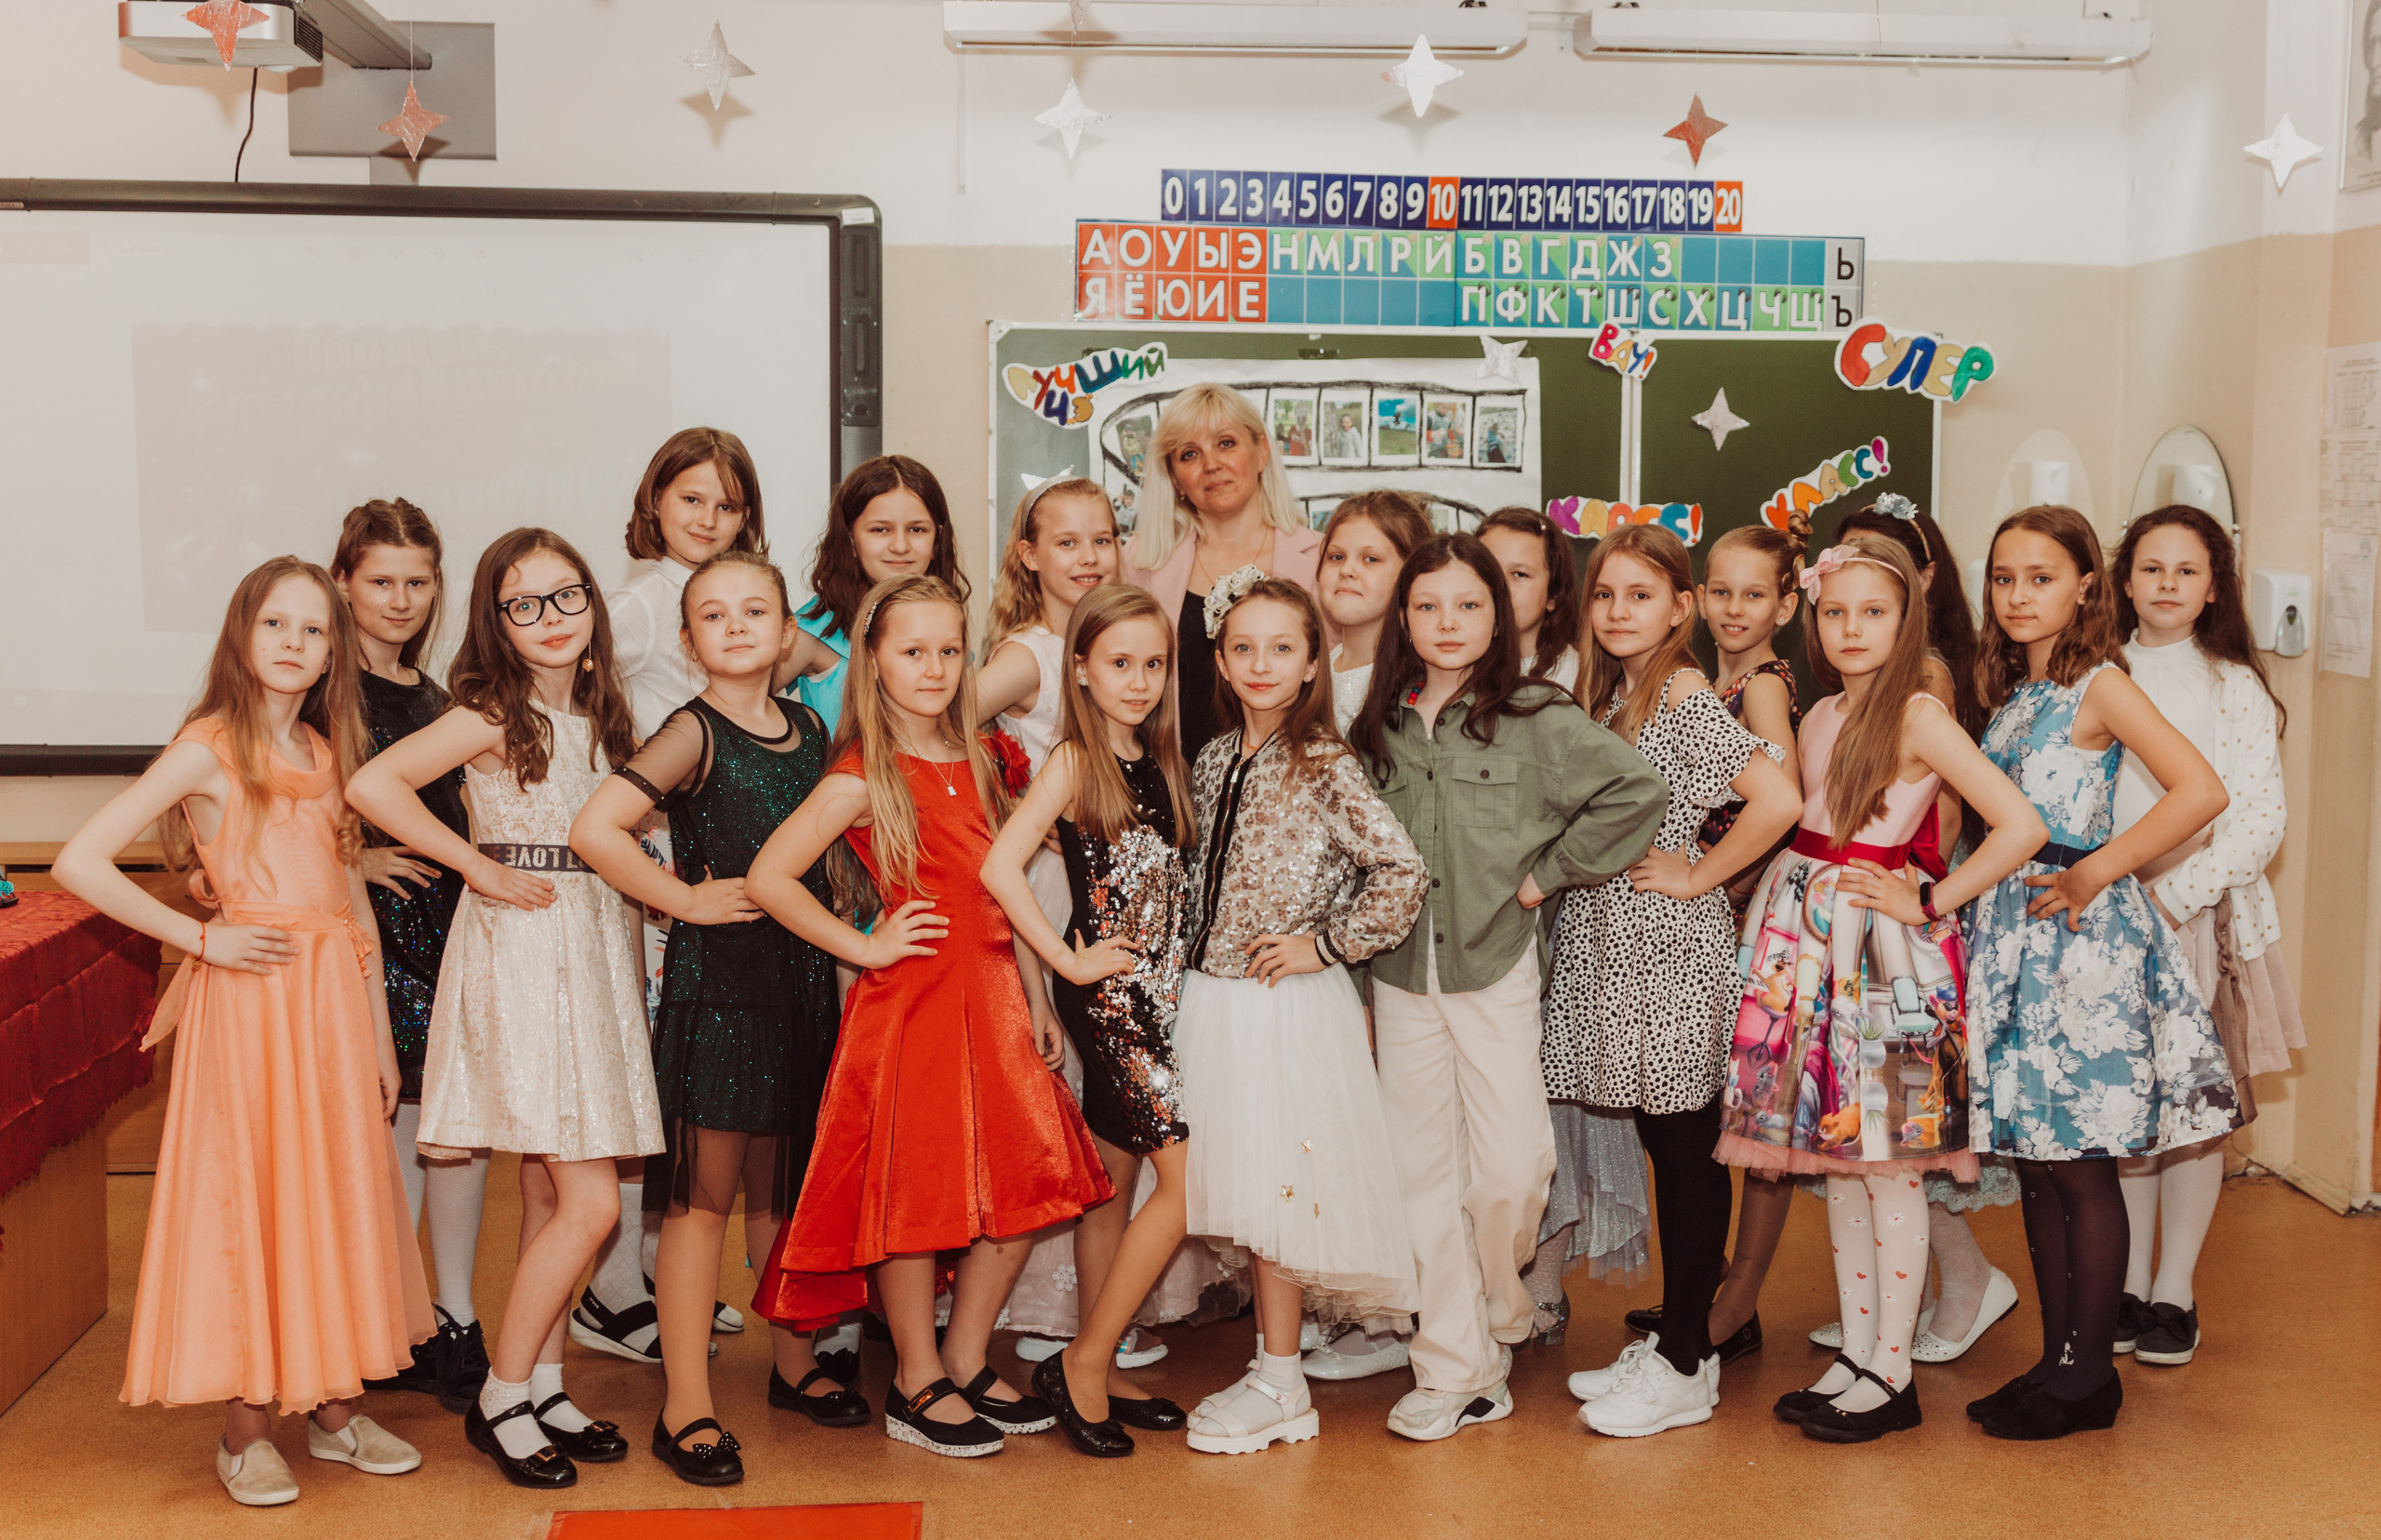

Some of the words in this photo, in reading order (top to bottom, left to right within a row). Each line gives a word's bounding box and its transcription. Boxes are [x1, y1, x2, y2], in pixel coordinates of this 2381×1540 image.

[1164, 178, 1183, 214] 0
[1194, 179, 1206, 215] 1
[1218, 179, 1237, 216] 2
[1245, 179, 1264, 217] 3
[1271, 179, 1292, 217] 4
[1299, 180, 1317, 218] 5
[1325, 181, 1344, 219] 6
[1353, 181, 1372, 219] 7
[1378, 182, 1398, 219] 8
[1405, 183, 1424, 220] 9
[1430, 183, 1456, 221] 10
[1461, 185, 1483, 221] 11
[1489, 185, 1513, 221] 12
[1518, 186, 1542, 222] 13
[1547, 186, 1571, 222] 14
[1576, 186, 1600, 223] 15
[1604, 186, 1629, 223] 16
[1632, 187, 1656, 224] 17
[1661, 187, 1684, 224] 18
[1689, 188, 1712, 225] 19
[1716, 188, 1740, 225] 20
[1082, 229, 1111, 265] А
[1119, 229, 1151, 267] О
[1160, 231, 1187, 268] У
[1198, 232, 1227, 268] Ы
[1237, 232, 1262, 269] Э
[1273, 233, 1298, 270] Н
[1307, 234, 1340, 271] М
[1348, 235, 1375, 272] Л
[1391, 236, 1411, 272] Р
[1426, 234, 1451, 273] Й
[1466, 238, 1485, 274] Б
[1503, 238, 1523, 274] В
[1541, 239, 1560, 274] Г
[1572, 239, 1600, 280] Д
[1606, 241, 1641, 276] Ж
[1650, 241, 1672, 278] З
[1838, 247, 1855, 280] Ь
[1085, 277, 1105, 313] Я
[1124, 273, 1144, 314] Ё
[1157, 278, 1190, 317] Ю
[1198, 280, 1225, 316] И
[1240, 281, 1260, 317] Е
[1463, 286, 1485, 322] П
[1496, 285, 1526, 322] Ф
[1538, 287, 1562, 323] К
[1576, 287, 1601, 324] Т
[1606, 288, 1639, 325] Ш
[1648, 288, 1672, 325] С
[1683, 290, 1710, 325] Х
[1722, 291, 1747, 330] Ц
[1759, 291, 1779, 326] Ч
[1790, 292, 1822, 331] Щ
[1832, 296, 1852, 327] Ъ
[1841, 324, 1994, 402] СУПЕР
